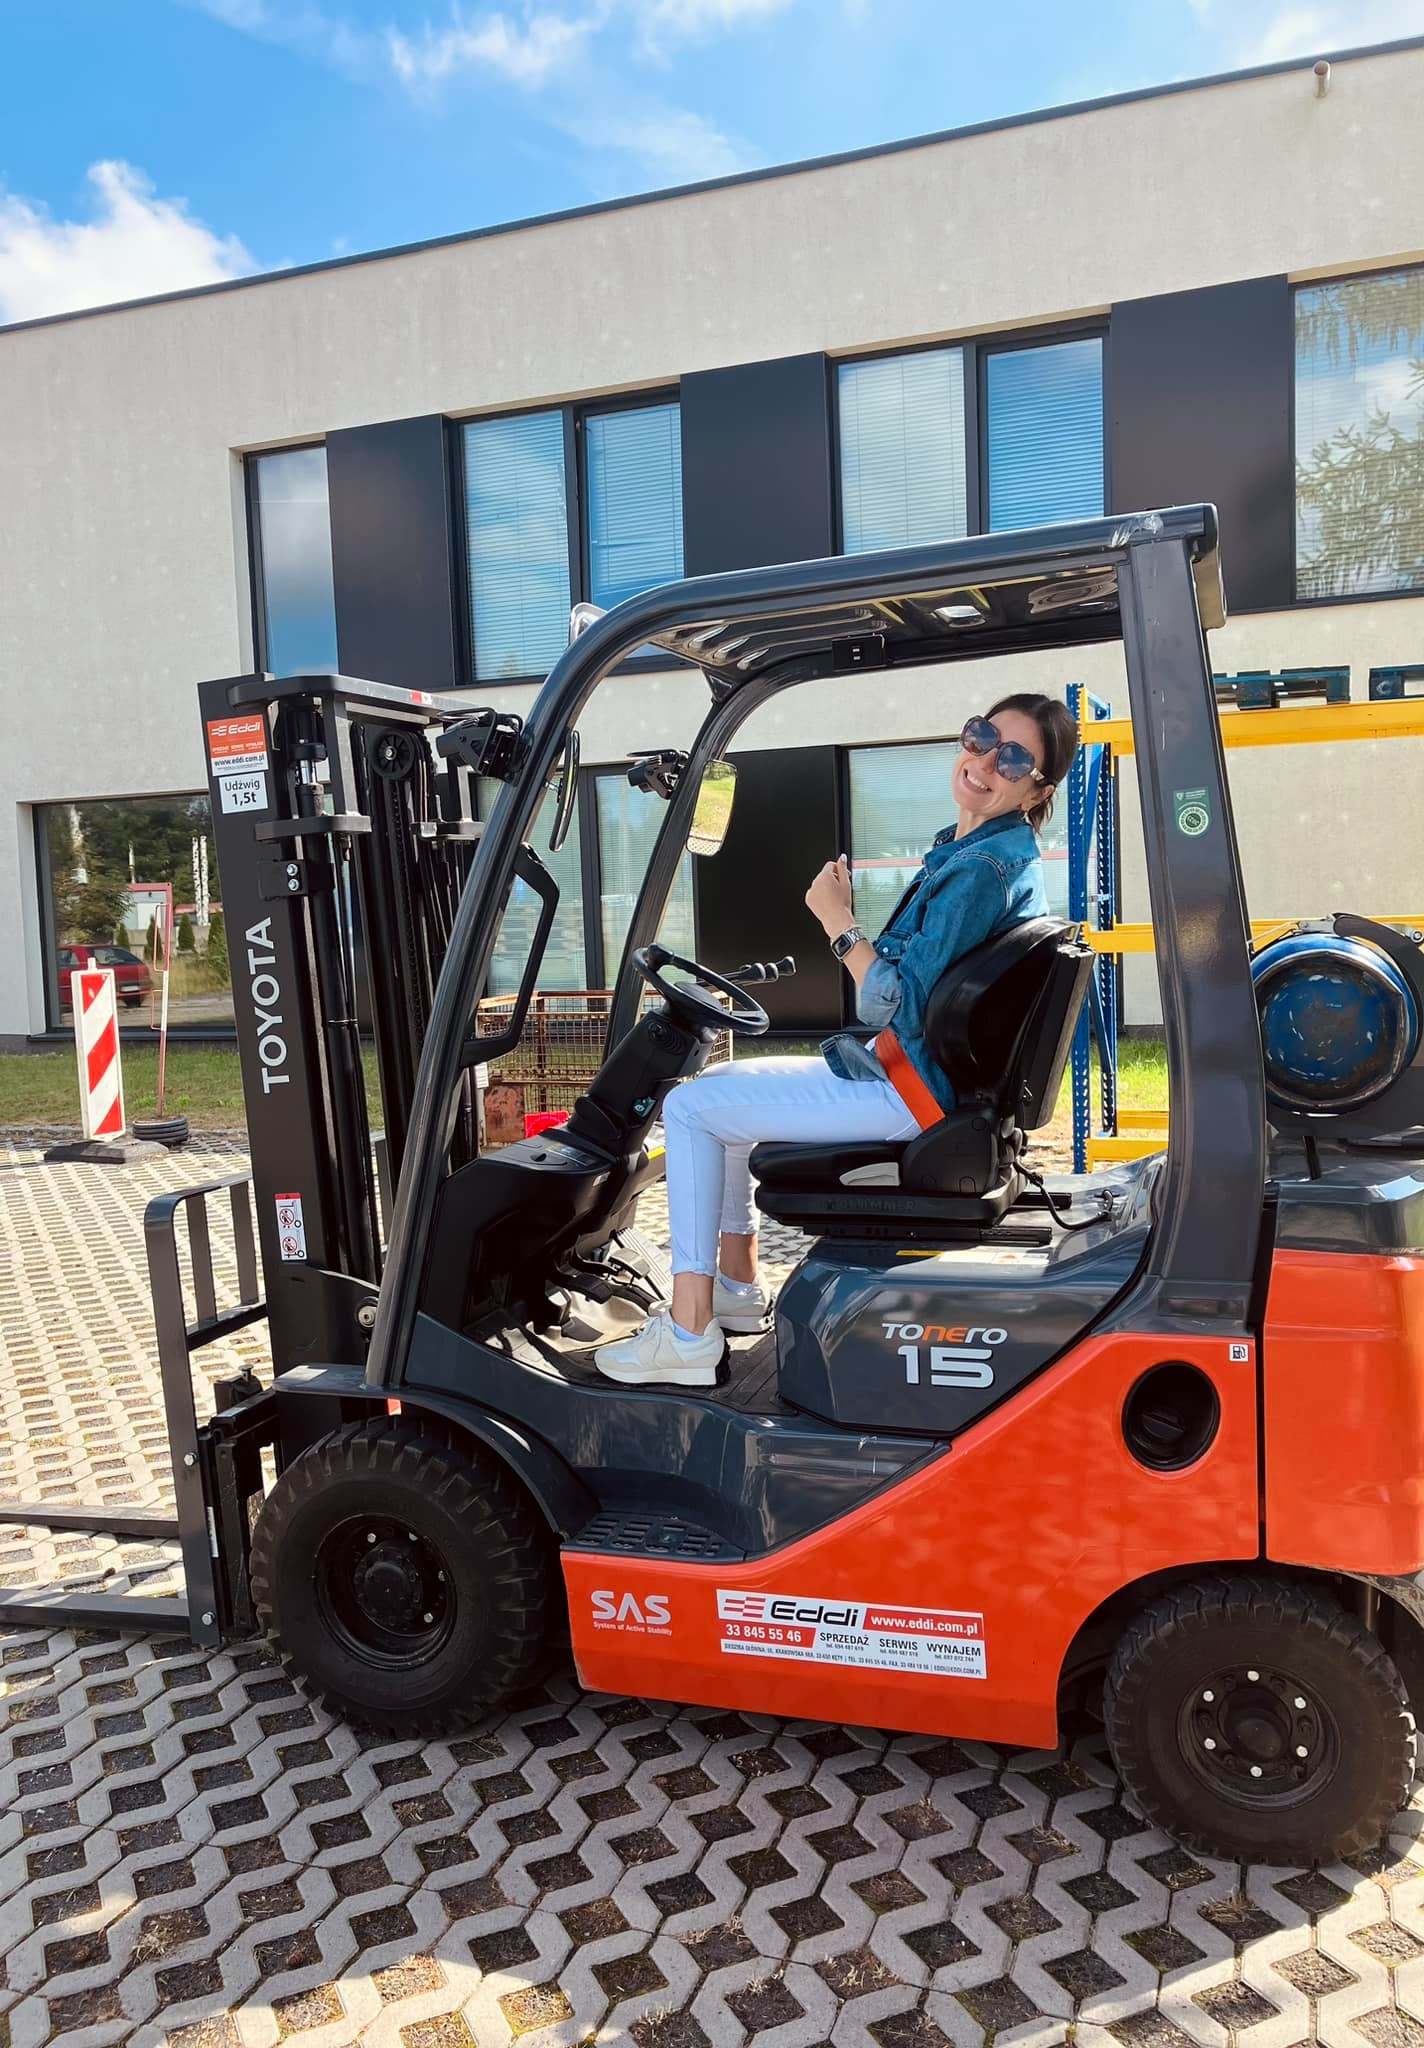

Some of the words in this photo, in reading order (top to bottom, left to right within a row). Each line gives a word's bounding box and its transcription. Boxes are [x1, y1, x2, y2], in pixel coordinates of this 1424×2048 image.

[228, 722, 261, 735] Eddi
[214, 753, 265, 767] www.eddi.com.pl
[231, 791, 257, 806] 1,5t
[245, 916, 290, 1094] TOYOTA
[897, 1345, 994, 1389] 15
[591, 1590, 672, 1625] SAS
[771, 1600, 859, 1627] Eddi
[593, 1621, 616, 1631] System
[626, 1624, 645, 1633] Active
[647, 1626, 672, 1636] Stability
[726, 1624, 741, 1636] 33
[744, 1626, 766, 1639] 845
[768, 1628, 784, 1640] 55
[786, 1630, 802, 1643] 46
[870, 1615, 979, 1636] www.eddi.com.pl
[820, 1632, 870, 1646] SPRZEDAŻ
[880, 1638, 918, 1650] SERWIS
[926, 1642, 981, 1656] WYNAJEM
